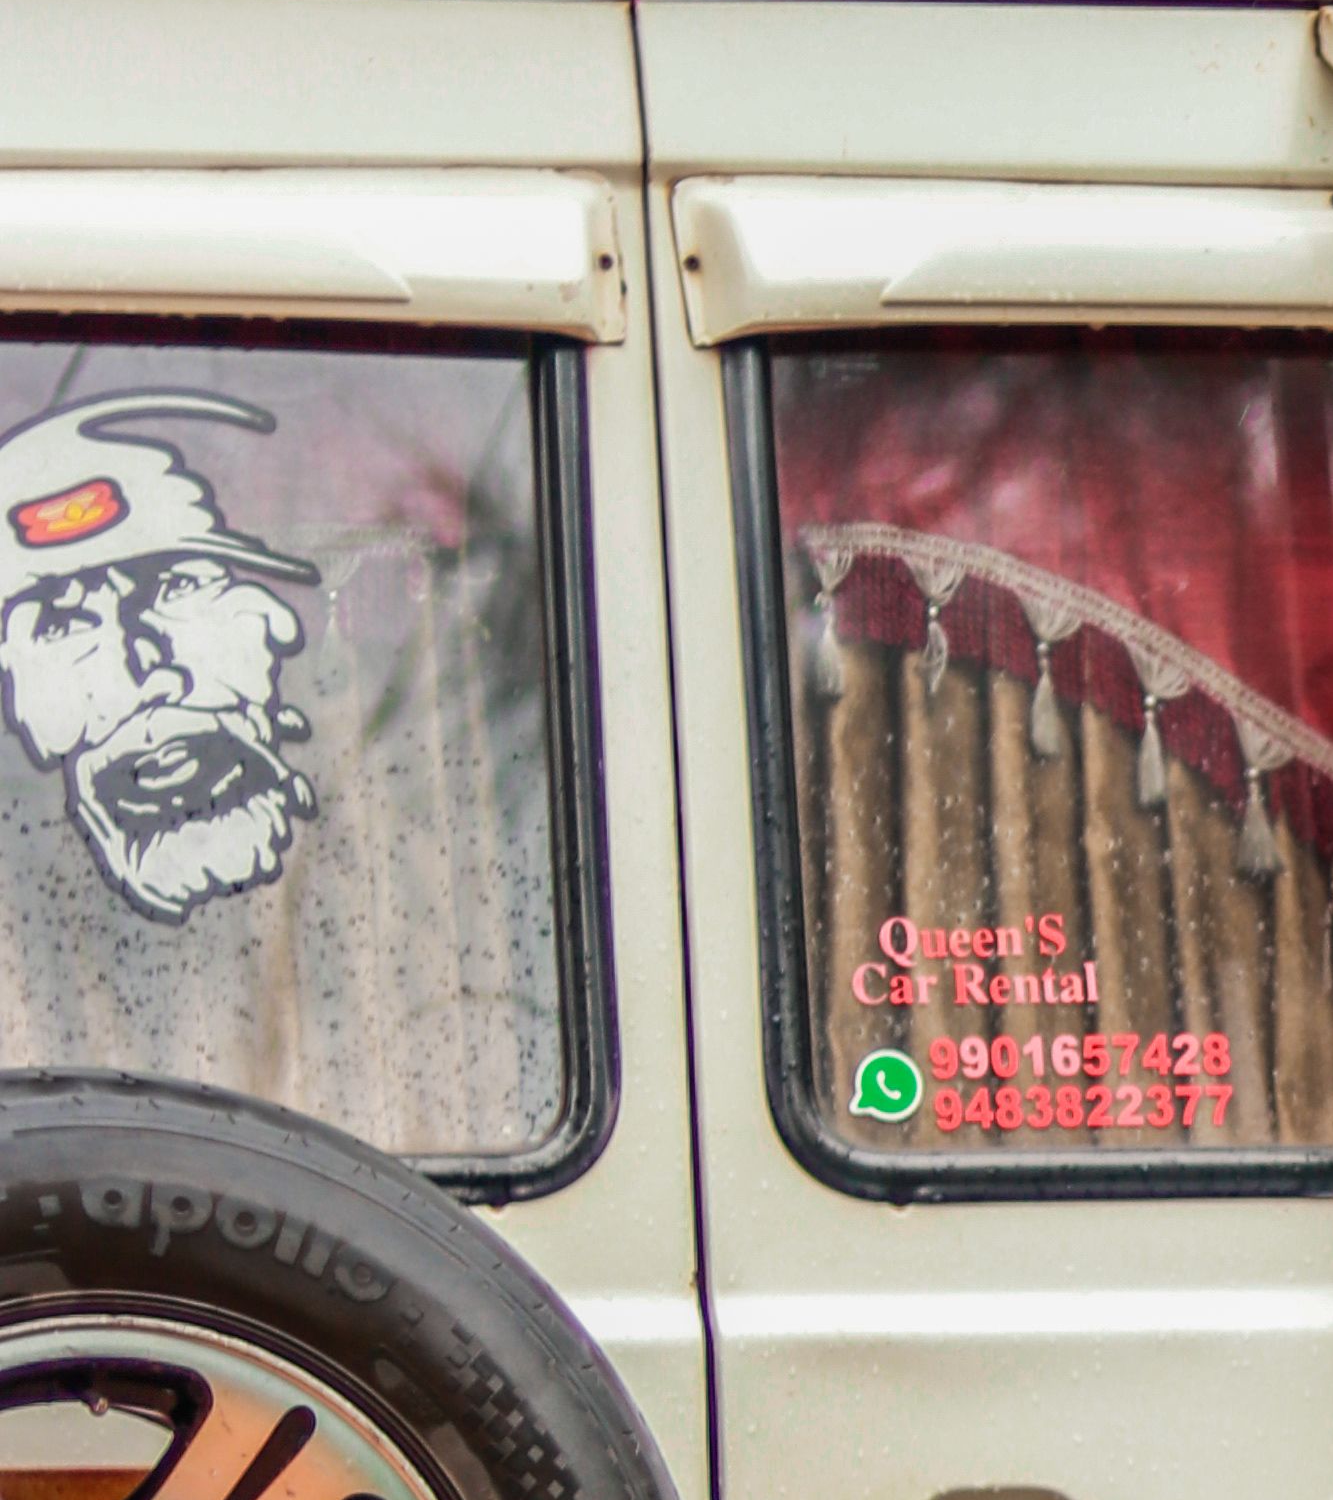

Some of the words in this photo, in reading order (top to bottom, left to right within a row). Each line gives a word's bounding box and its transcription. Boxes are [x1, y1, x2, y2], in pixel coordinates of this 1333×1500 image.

[878, 913, 1068, 968] Queen'S
[851, 961, 938, 1006] Car
[953, 961, 1100, 1005] Rental
[929, 1032, 1232, 1080] 9901657428
[933, 1084, 1234, 1132] 9483822377
